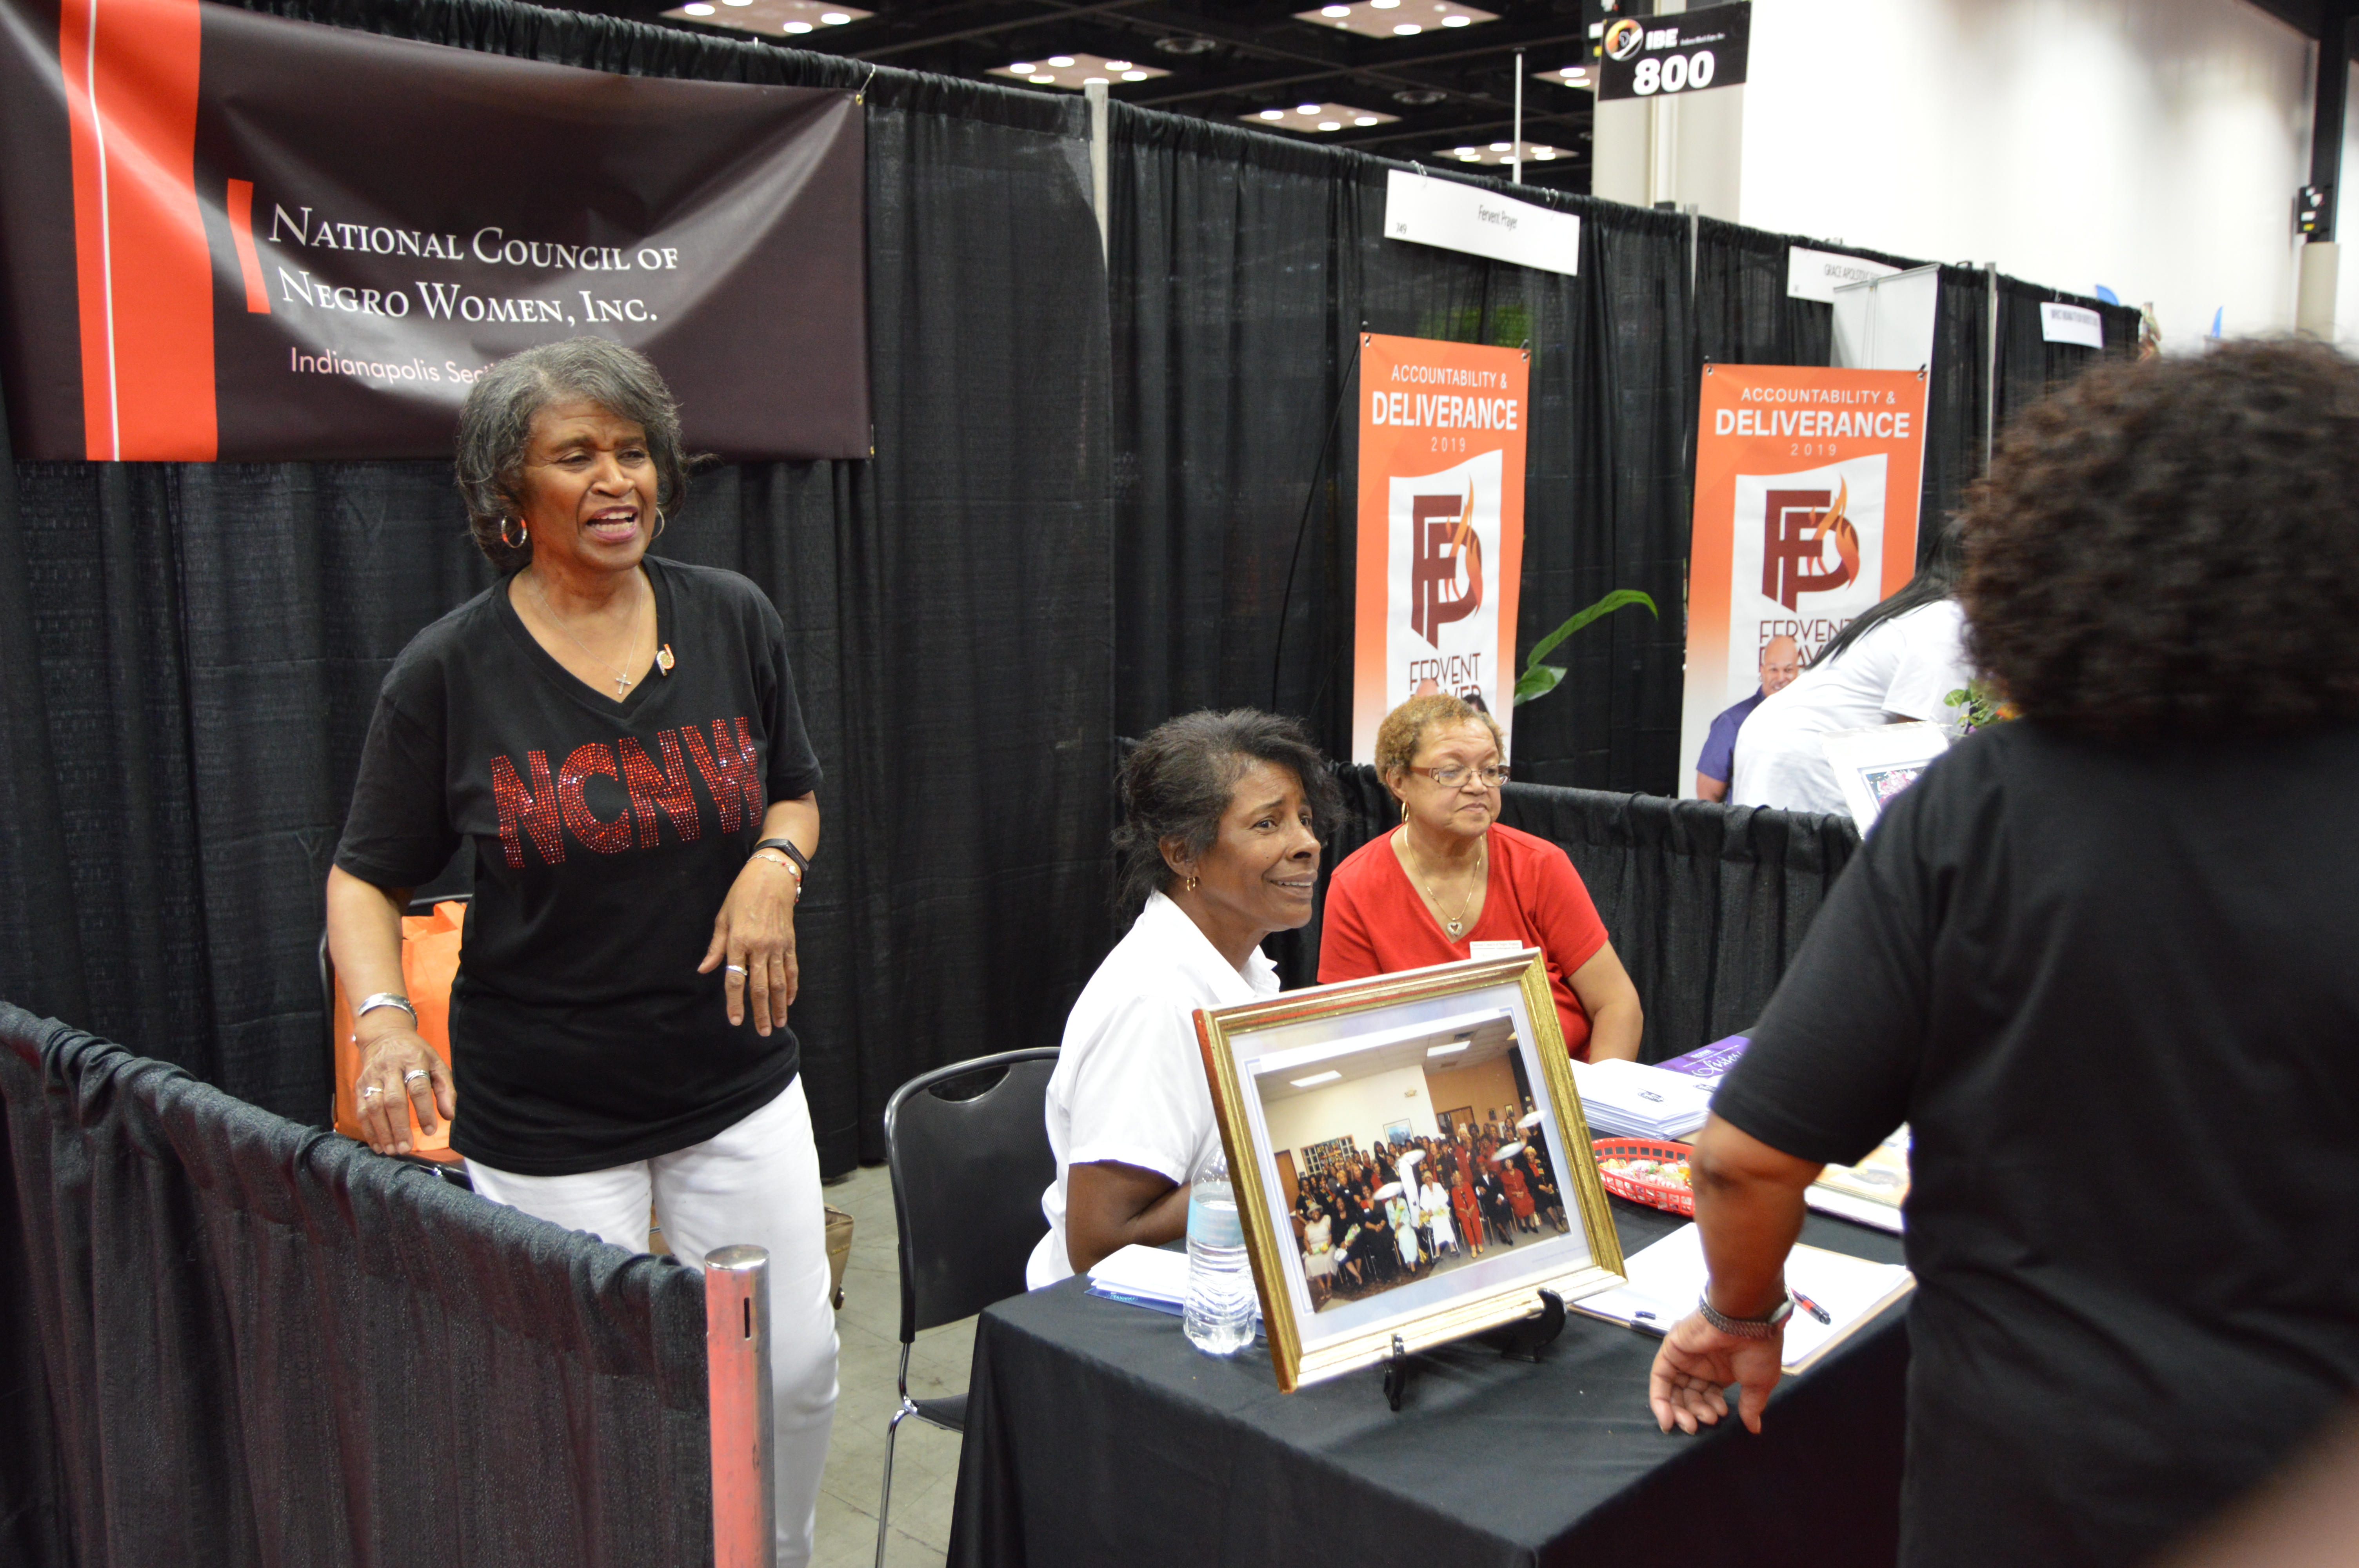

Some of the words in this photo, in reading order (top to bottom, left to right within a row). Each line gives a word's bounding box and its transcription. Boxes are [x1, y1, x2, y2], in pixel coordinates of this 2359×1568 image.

[1645, 27, 1679, 51] IBE
[1632, 50, 1715, 96] 800
[1396, 222, 1407, 234] 749
[1478, 204, 1500, 225] Fervent
[1501, 210, 1518, 231] Prayer
[1825, 263, 1842, 278] GRACE
[291, 347, 440, 384] Indianapolis
[445, 360, 494, 384] Sec
[1391, 364, 1497, 388] ACCOUNTABILITY
[1500, 373, 1507, 389] &
[1740, 387, 1881, 404] ACCOUNTABILITY
[1886, 391, 1895, 405] &
[1372, 390, 1518, 430] DELIVERANCE
[1715, 408, 1910, 438] DELIVERANCE
[1431, 436, 1466, 452] 2019
[1790, 443, 1837, 456] 2019
[490, 716, 762, 868] NCNW
